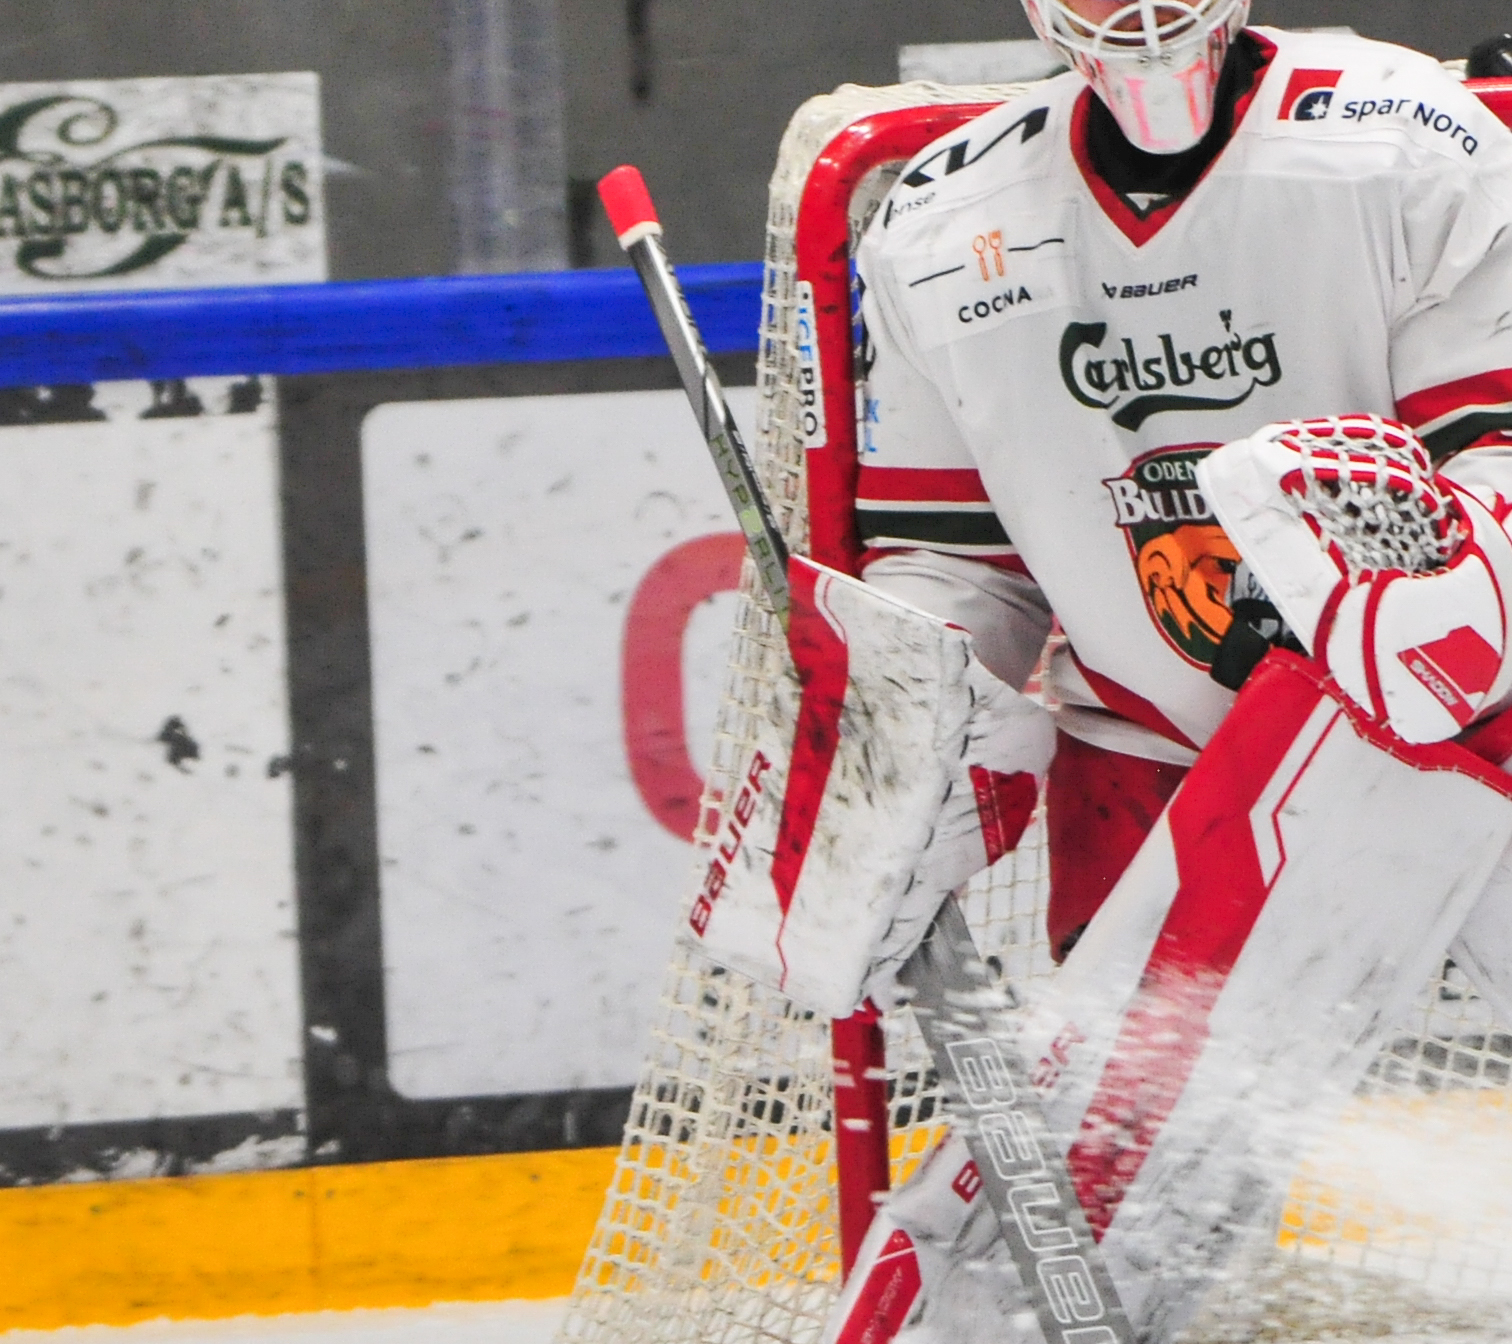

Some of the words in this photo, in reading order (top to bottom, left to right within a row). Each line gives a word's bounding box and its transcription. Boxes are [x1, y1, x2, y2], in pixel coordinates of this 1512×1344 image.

[218, 158, 311, 239] A/S
[1059, 320, 1283, 416] Carlsberg
[1106, 479, 1216, 526] BULLD
[1143, 459, 1200, 483] ODEN
[689, 748, 774, 939] BAUER
